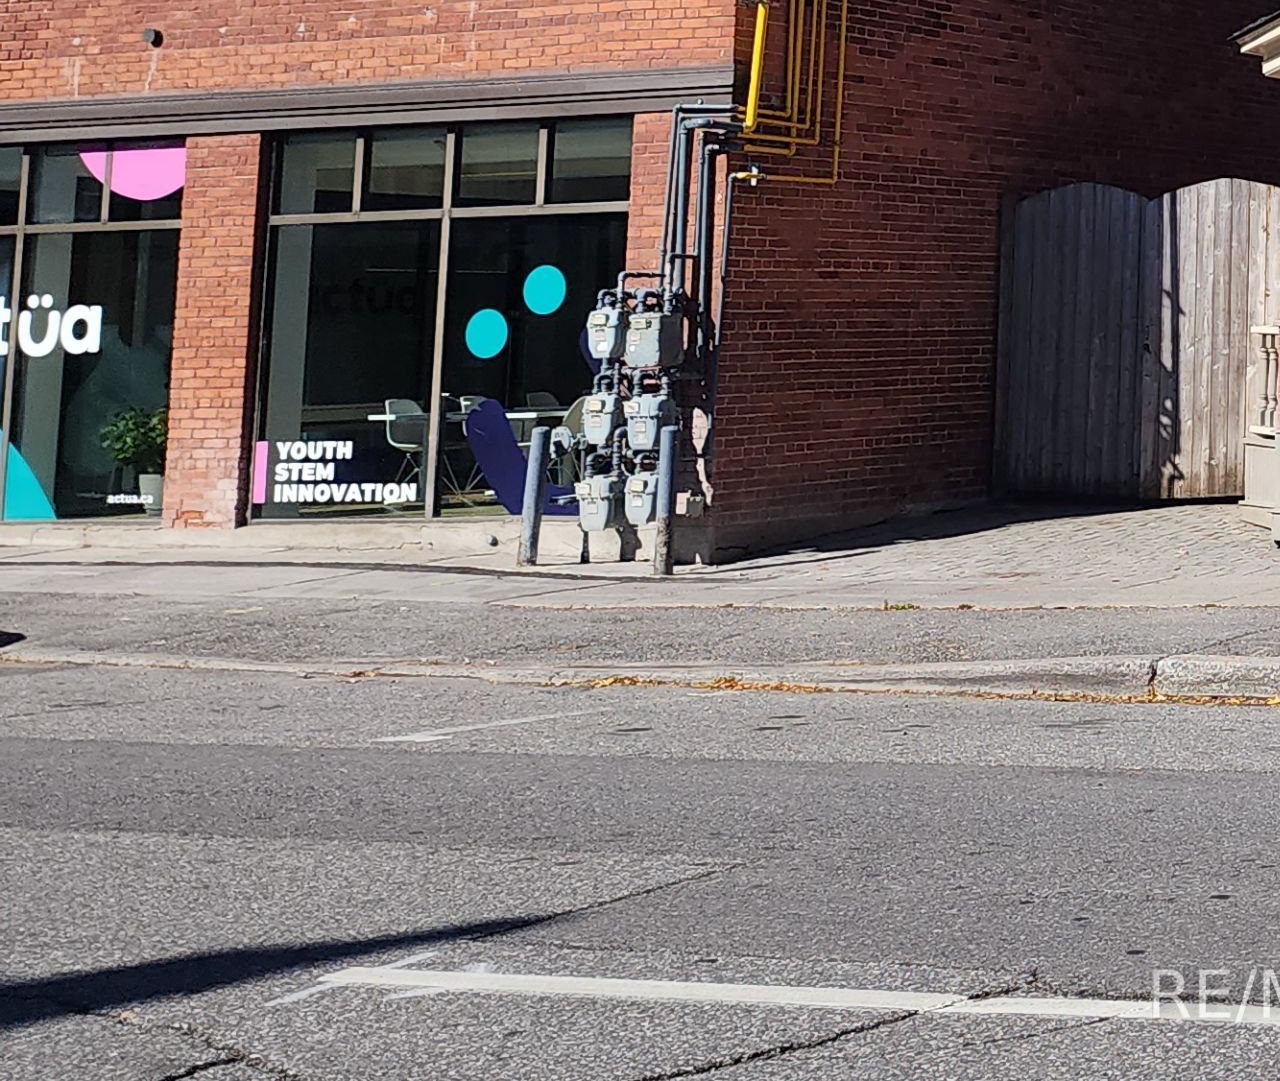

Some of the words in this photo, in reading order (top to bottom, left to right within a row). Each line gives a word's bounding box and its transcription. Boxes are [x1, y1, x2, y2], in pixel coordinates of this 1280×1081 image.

[275, 440, 354, 460] YOUTH
[274, 462, 335, 482] STEM
[105, 493, 154, 504] actua.ca
[273, 482, 418, 503] INNOVATION
